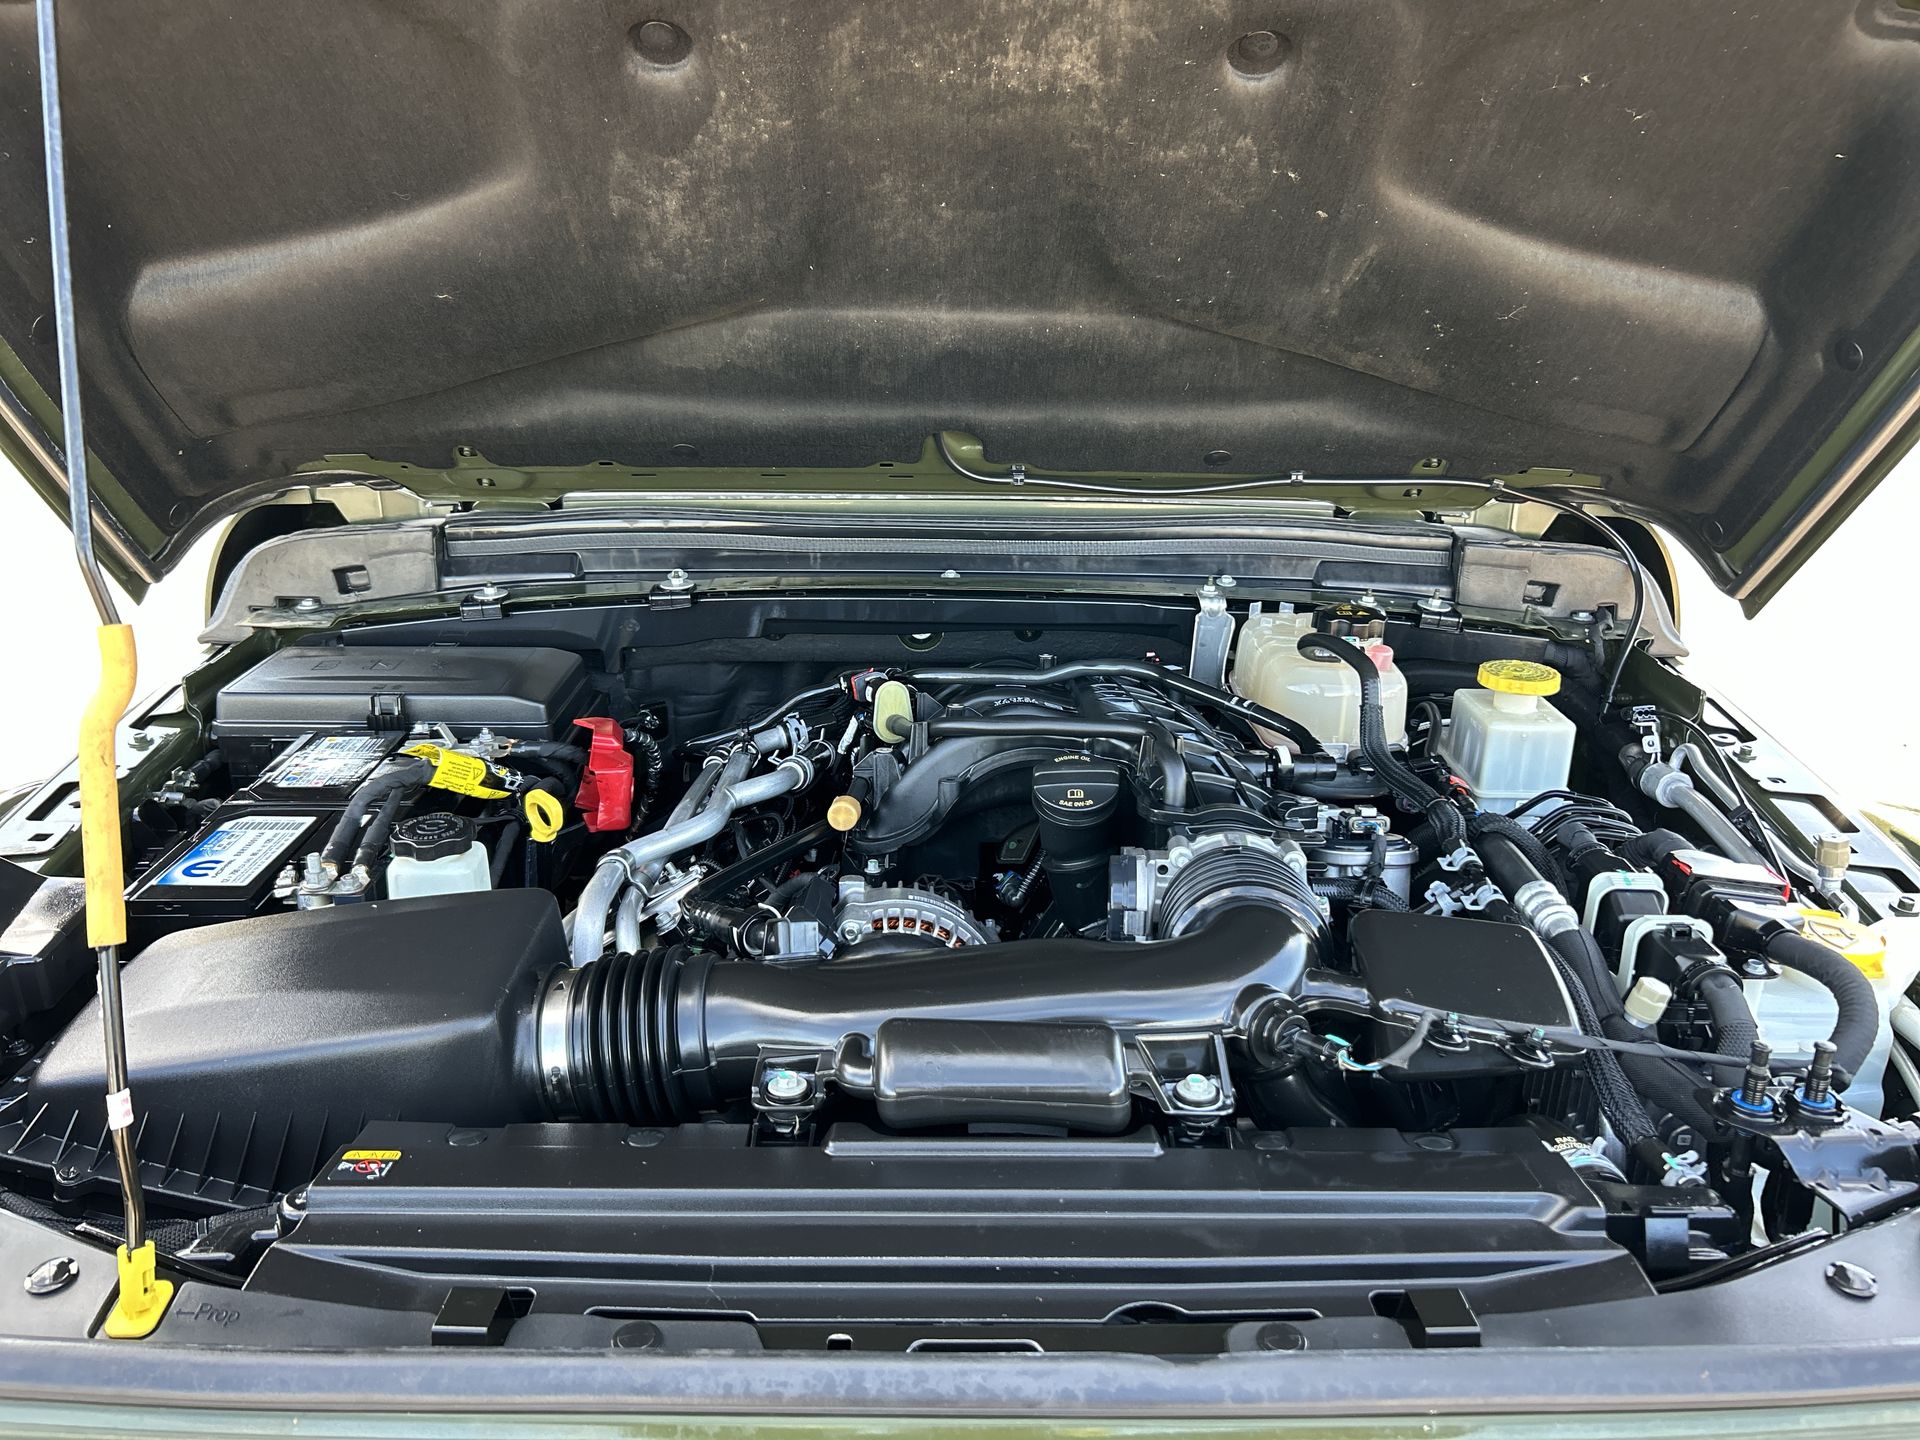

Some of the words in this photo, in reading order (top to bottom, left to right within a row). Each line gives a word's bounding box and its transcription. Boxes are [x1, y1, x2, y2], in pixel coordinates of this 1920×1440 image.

[1054, 755, 1080, 763] ENGINE
[1059, 799, 1073, 807] SAE
[1073, 799, 1094, 807] 0W-20
[194, 1302, 240, 1328] Prop
